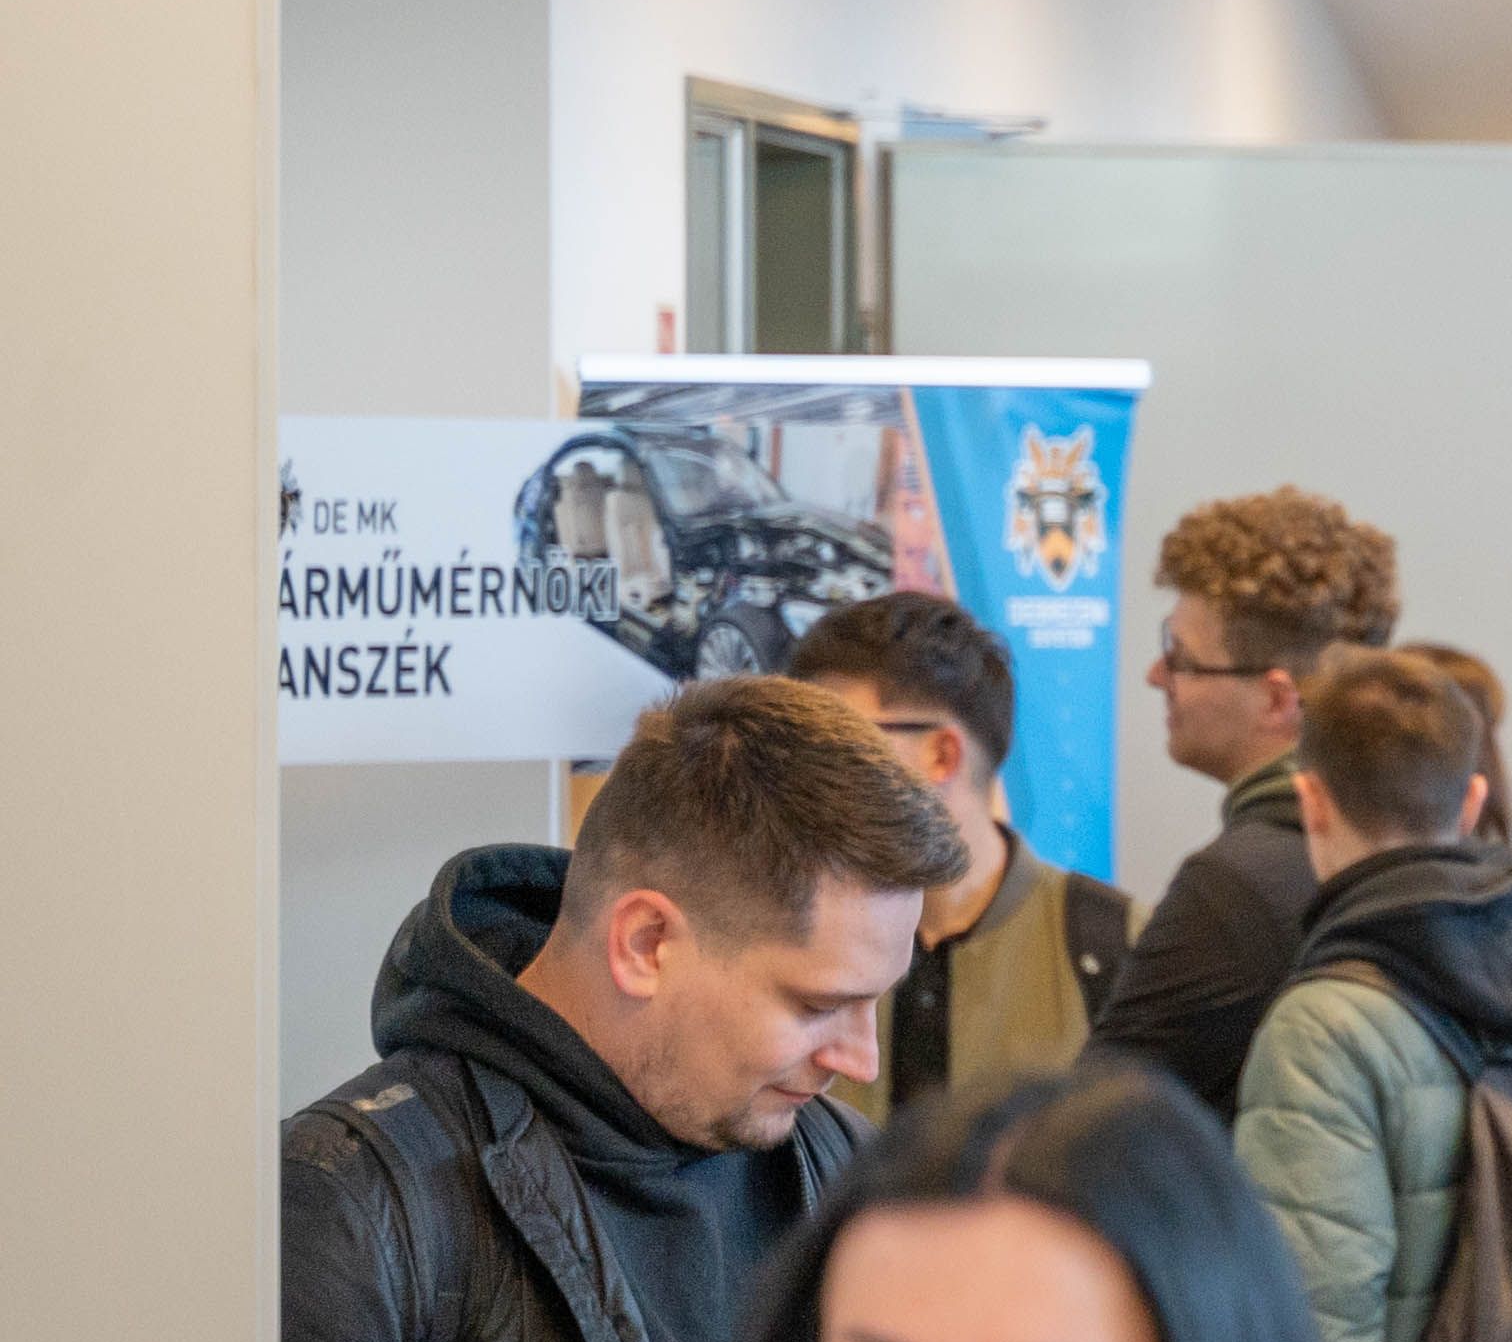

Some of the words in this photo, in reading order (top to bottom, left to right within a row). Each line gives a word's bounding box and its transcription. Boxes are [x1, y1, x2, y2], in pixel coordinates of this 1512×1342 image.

[313, 500, 347, 535] DE
[356, 500, 398, 535] MK
[278, 548, 619, 619] ÁRMŰMÉRNÖKI
[278, 628, 453, 697] ANSZÉK
